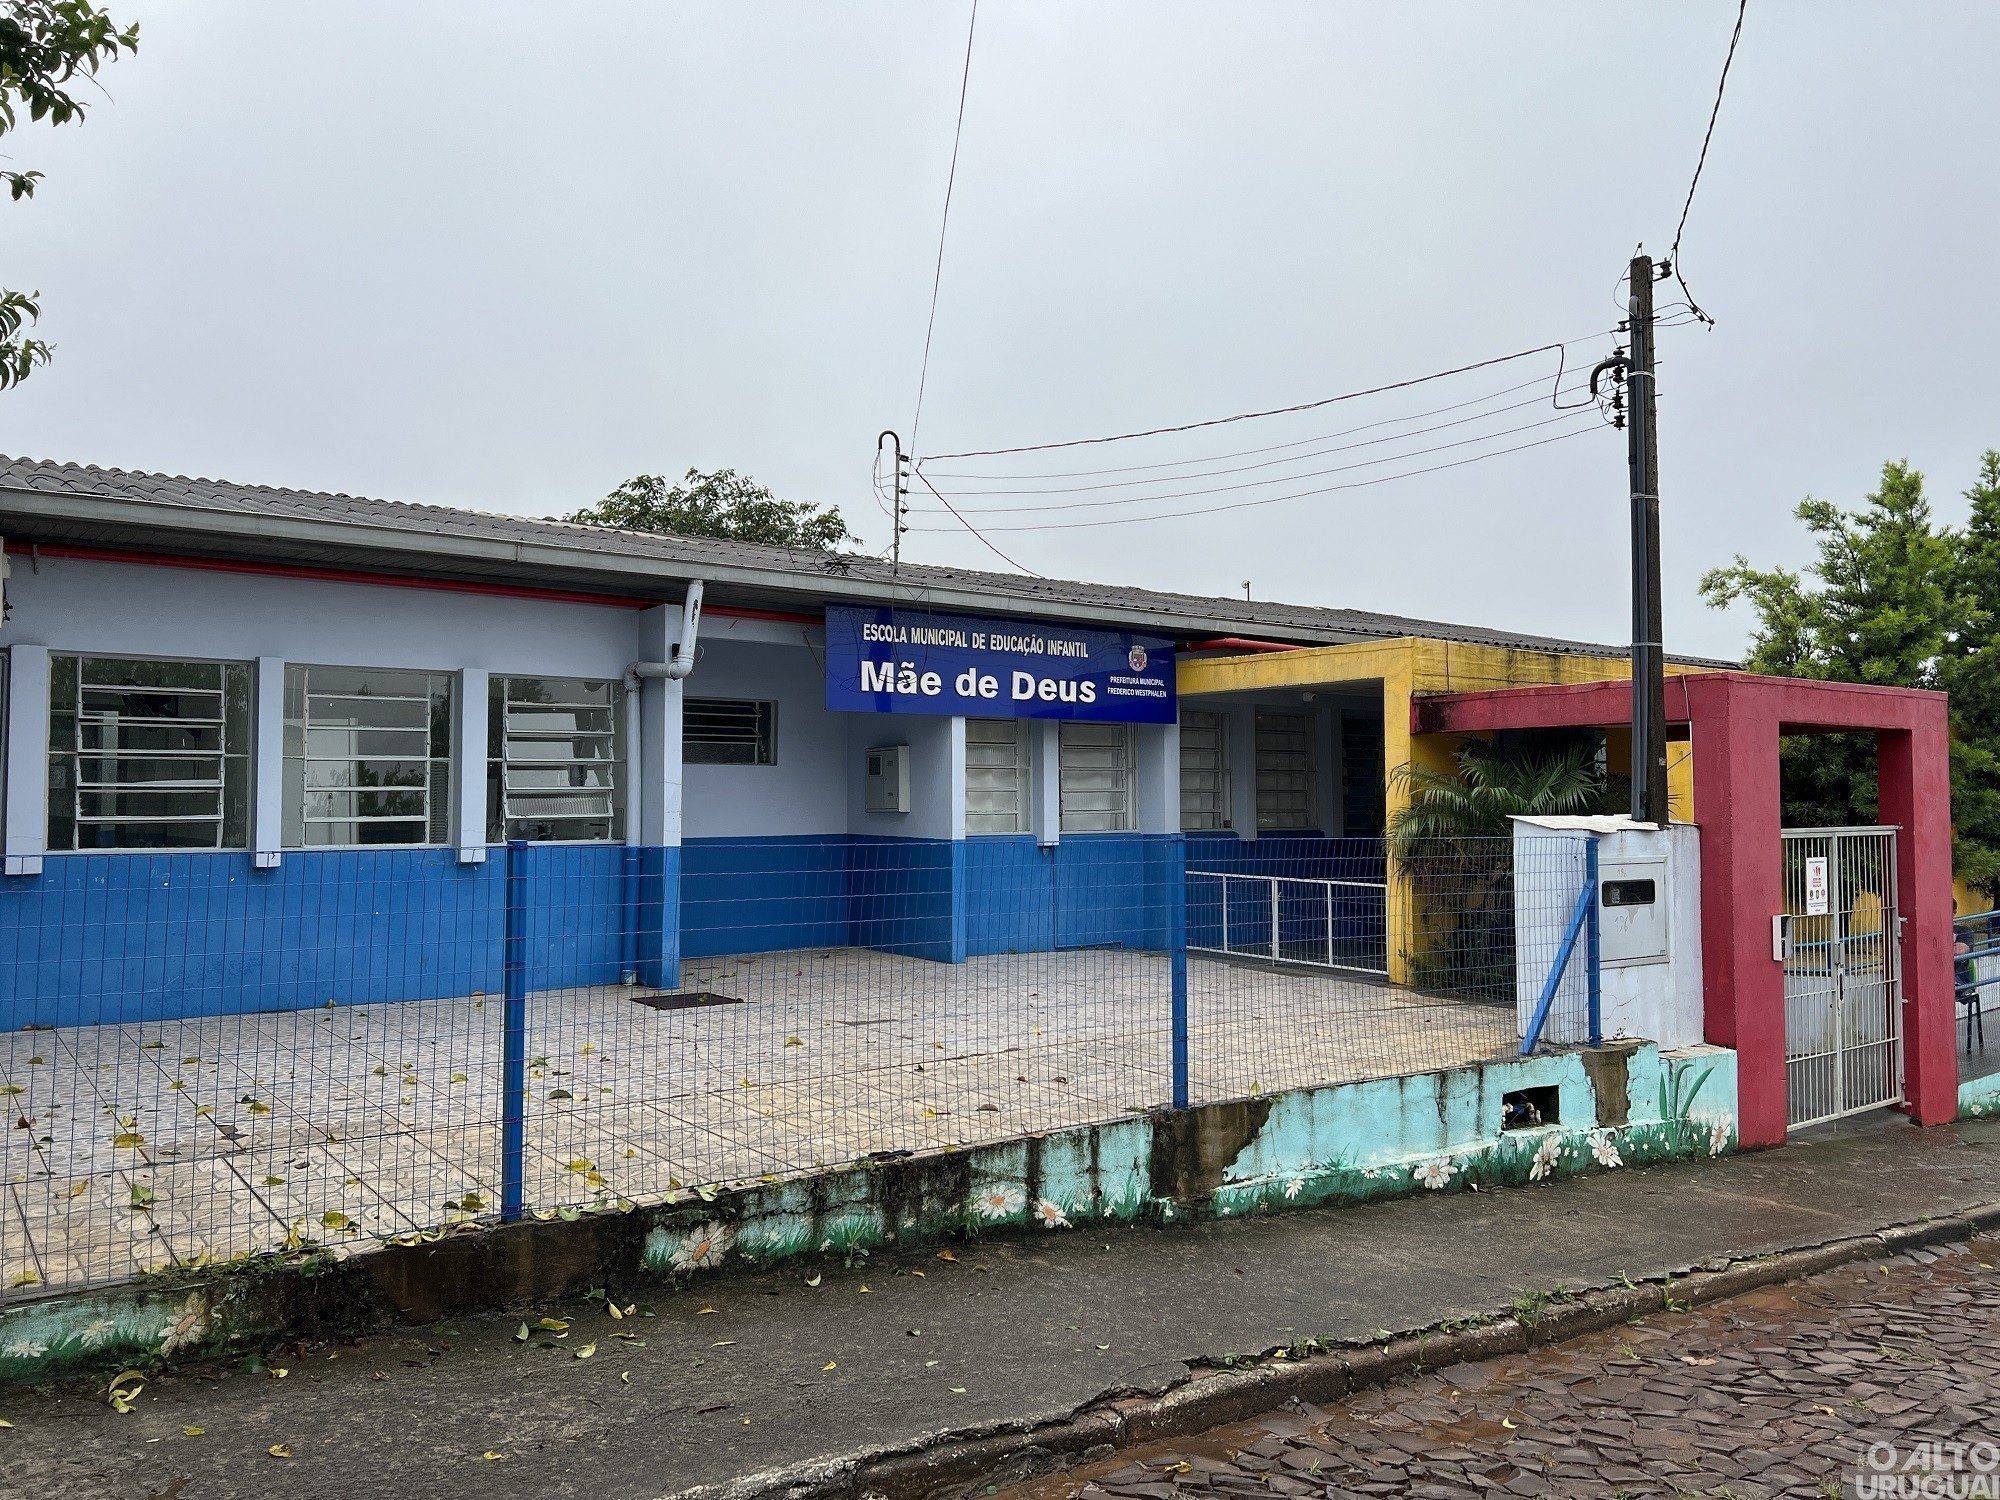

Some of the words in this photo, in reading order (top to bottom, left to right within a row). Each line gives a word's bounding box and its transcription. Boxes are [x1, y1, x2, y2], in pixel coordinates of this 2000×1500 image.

[863, 623, 907, 643] ESCOLA
[911, 627, 968, 648] MUNICIPAL
[972, 632, 986, 650] DE
[990, 634, 1044, 656] EDUCAÇÃO
[1047, 639, 1088, 658] INFANTIL
[861, 660, 942, 696] Mãe
[955, 667, 999, 699] de
[1012, 671, 1096, 703] Deus
[1107, 687, 1135, 696] FREDERICO
[1135, 689, 1167, 698] WESTPHALEN
[1110, 676, 1139, 685] PREFEITURA
[1140, 678, 1165, 686] MUNICIPAL
